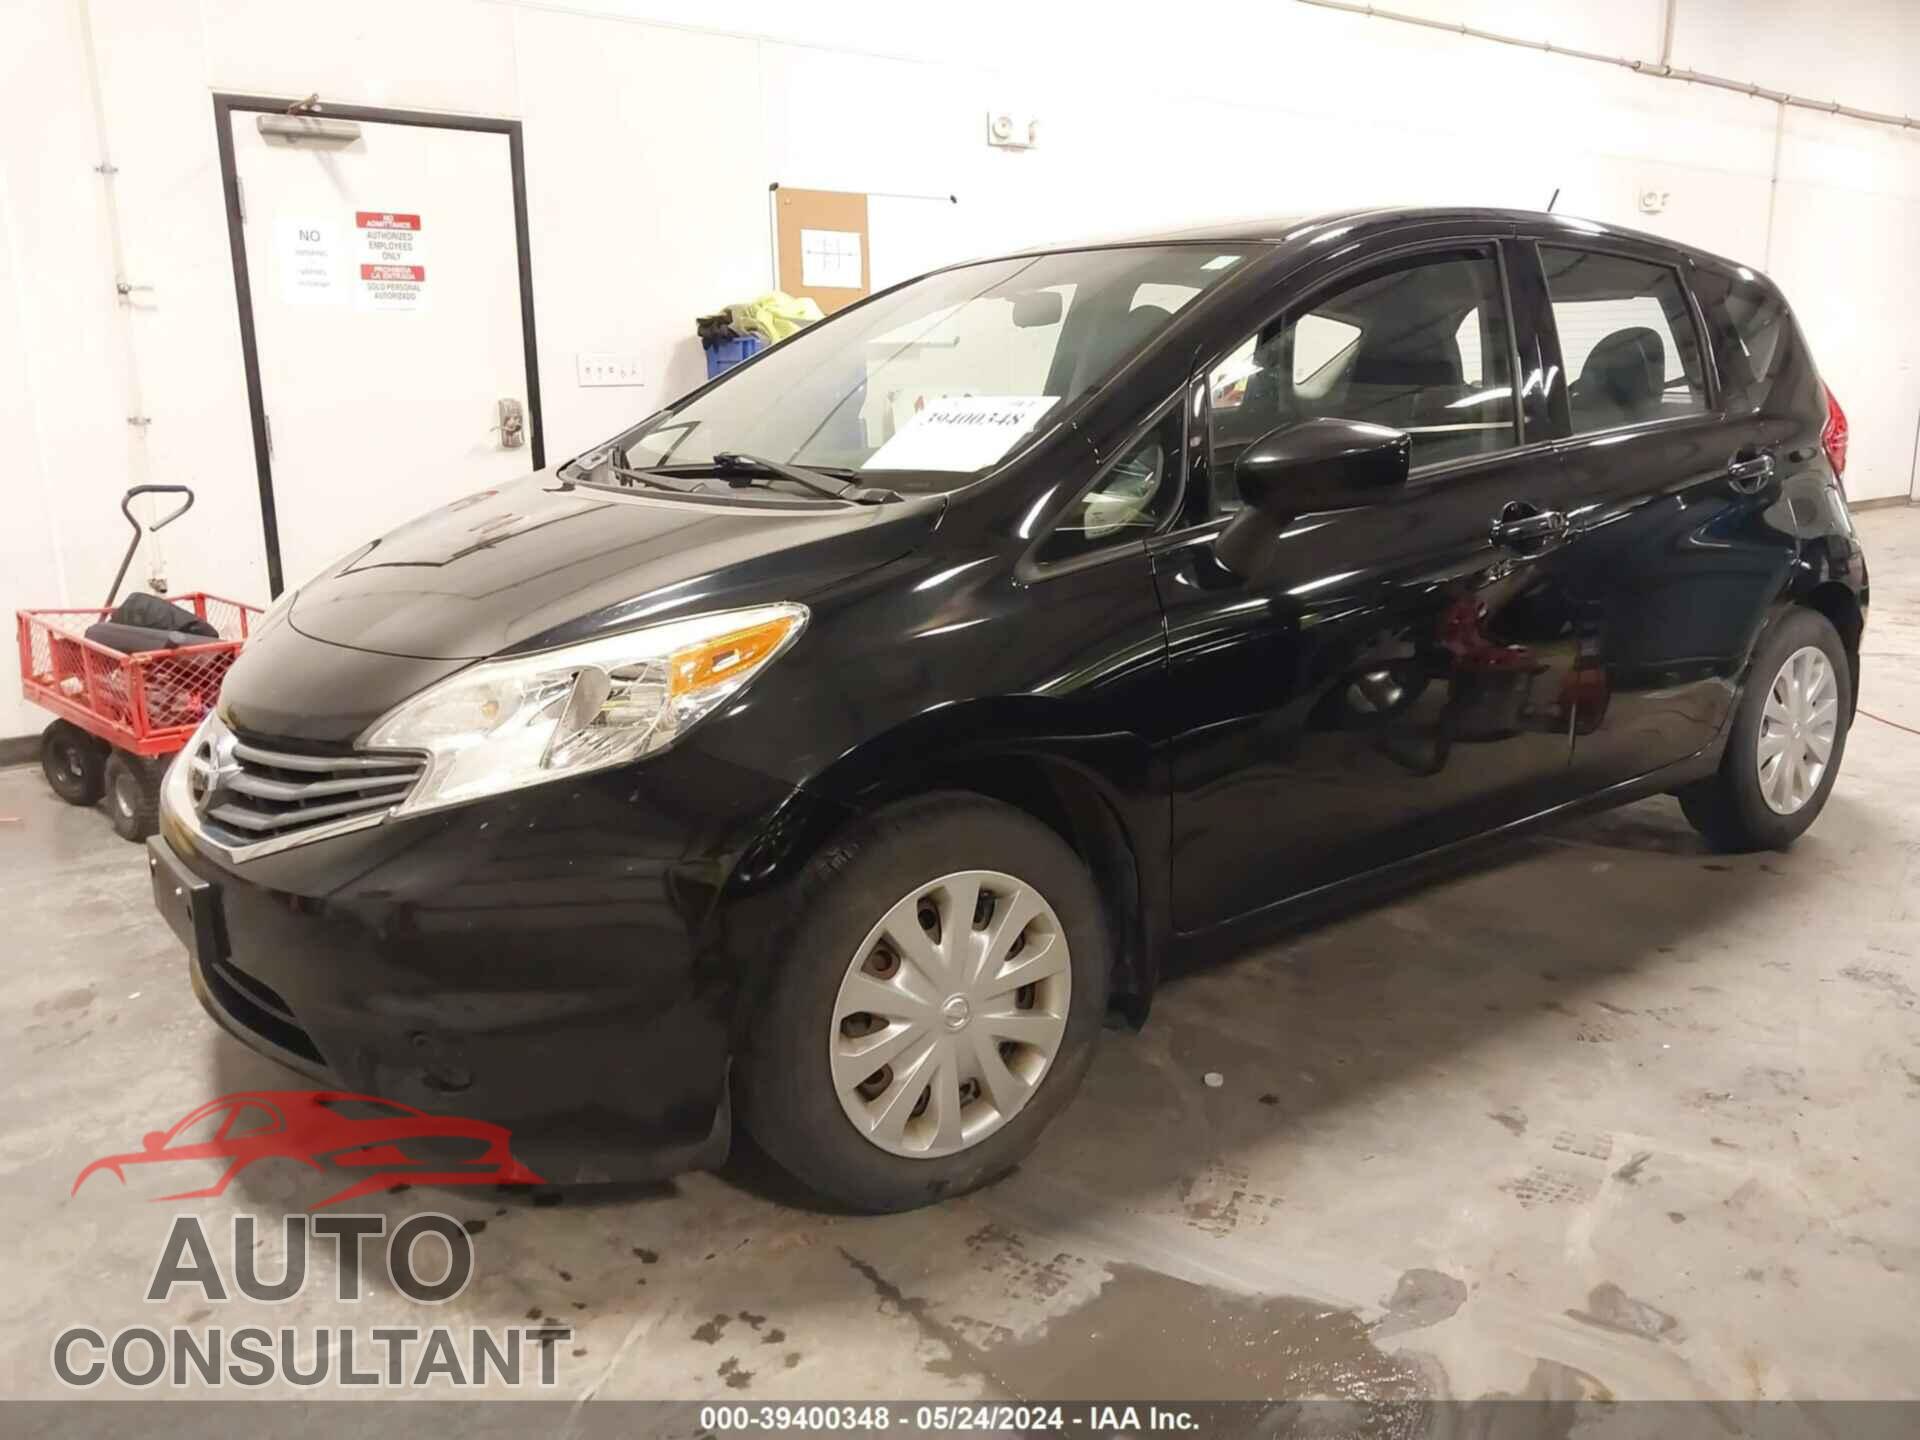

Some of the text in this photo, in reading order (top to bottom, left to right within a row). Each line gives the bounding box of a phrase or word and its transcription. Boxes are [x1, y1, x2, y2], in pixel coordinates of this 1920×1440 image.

[298, 229, 321, 242] NO
[367, 231, 414, 241] AUTHORIZED
[368, 241, 413, 251] EMPLOYEES
[382, 251, 401, 260] ONLY
[387, 282, 421, 291] PERSONAL
[374, 292, 417, 301] AUTORIZADO
